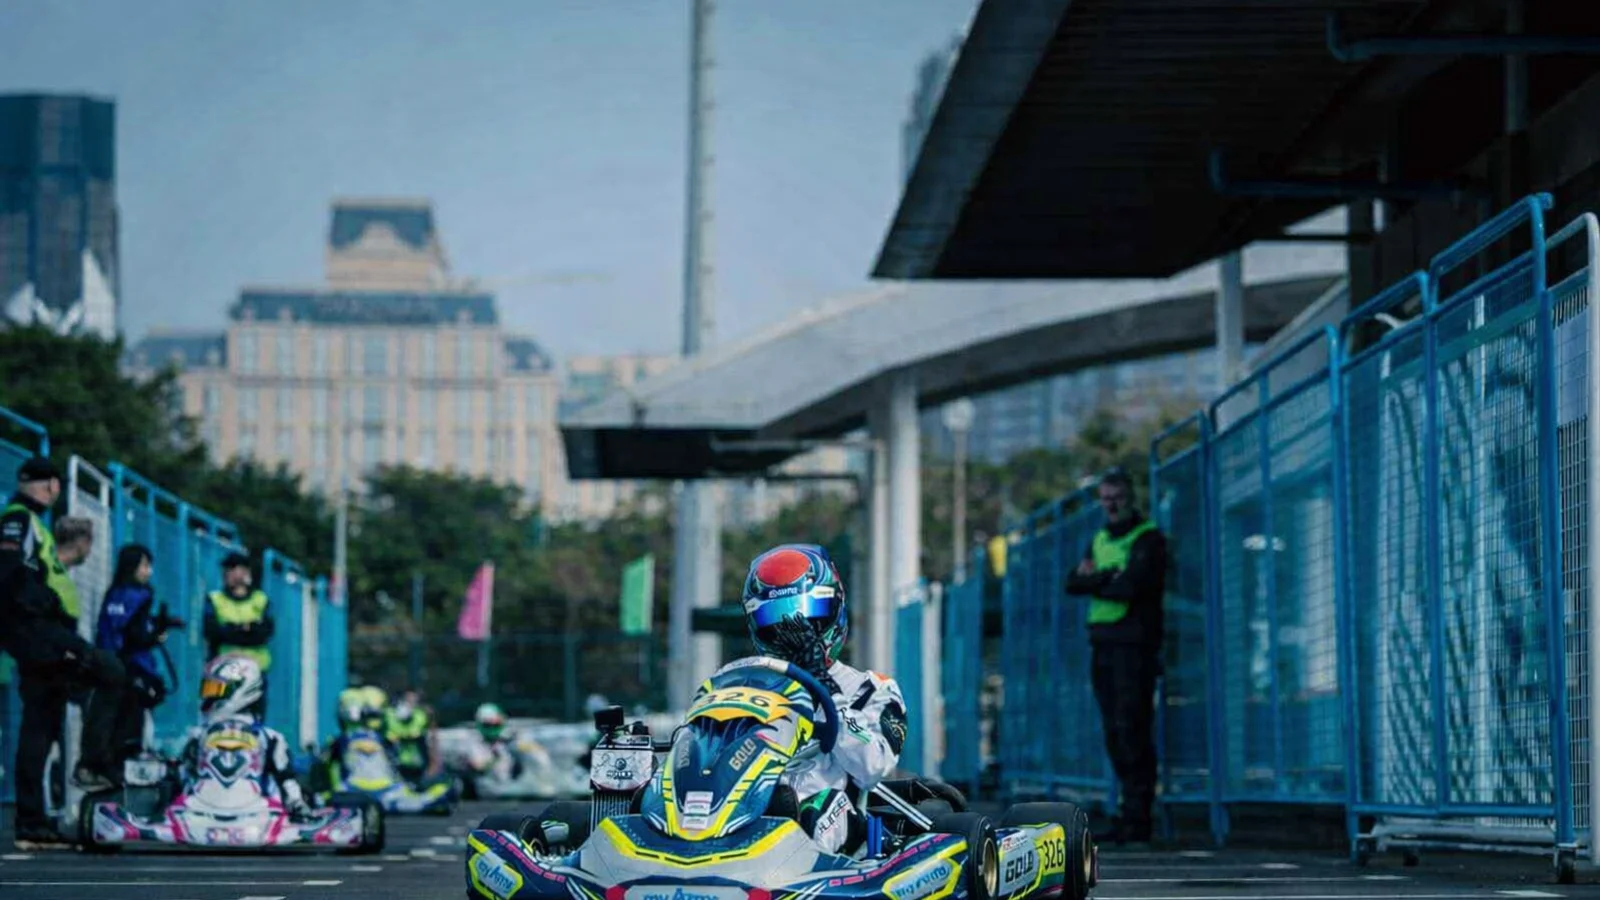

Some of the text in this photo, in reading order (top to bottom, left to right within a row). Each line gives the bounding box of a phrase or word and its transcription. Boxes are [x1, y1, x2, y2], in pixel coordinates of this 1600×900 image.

[697, 691, 771, 708] 326
[729, 737, 757, 771] GOLD
[1005, 850, 1034, 883] GOLD
[1043, 837, 1064, 870] 326
